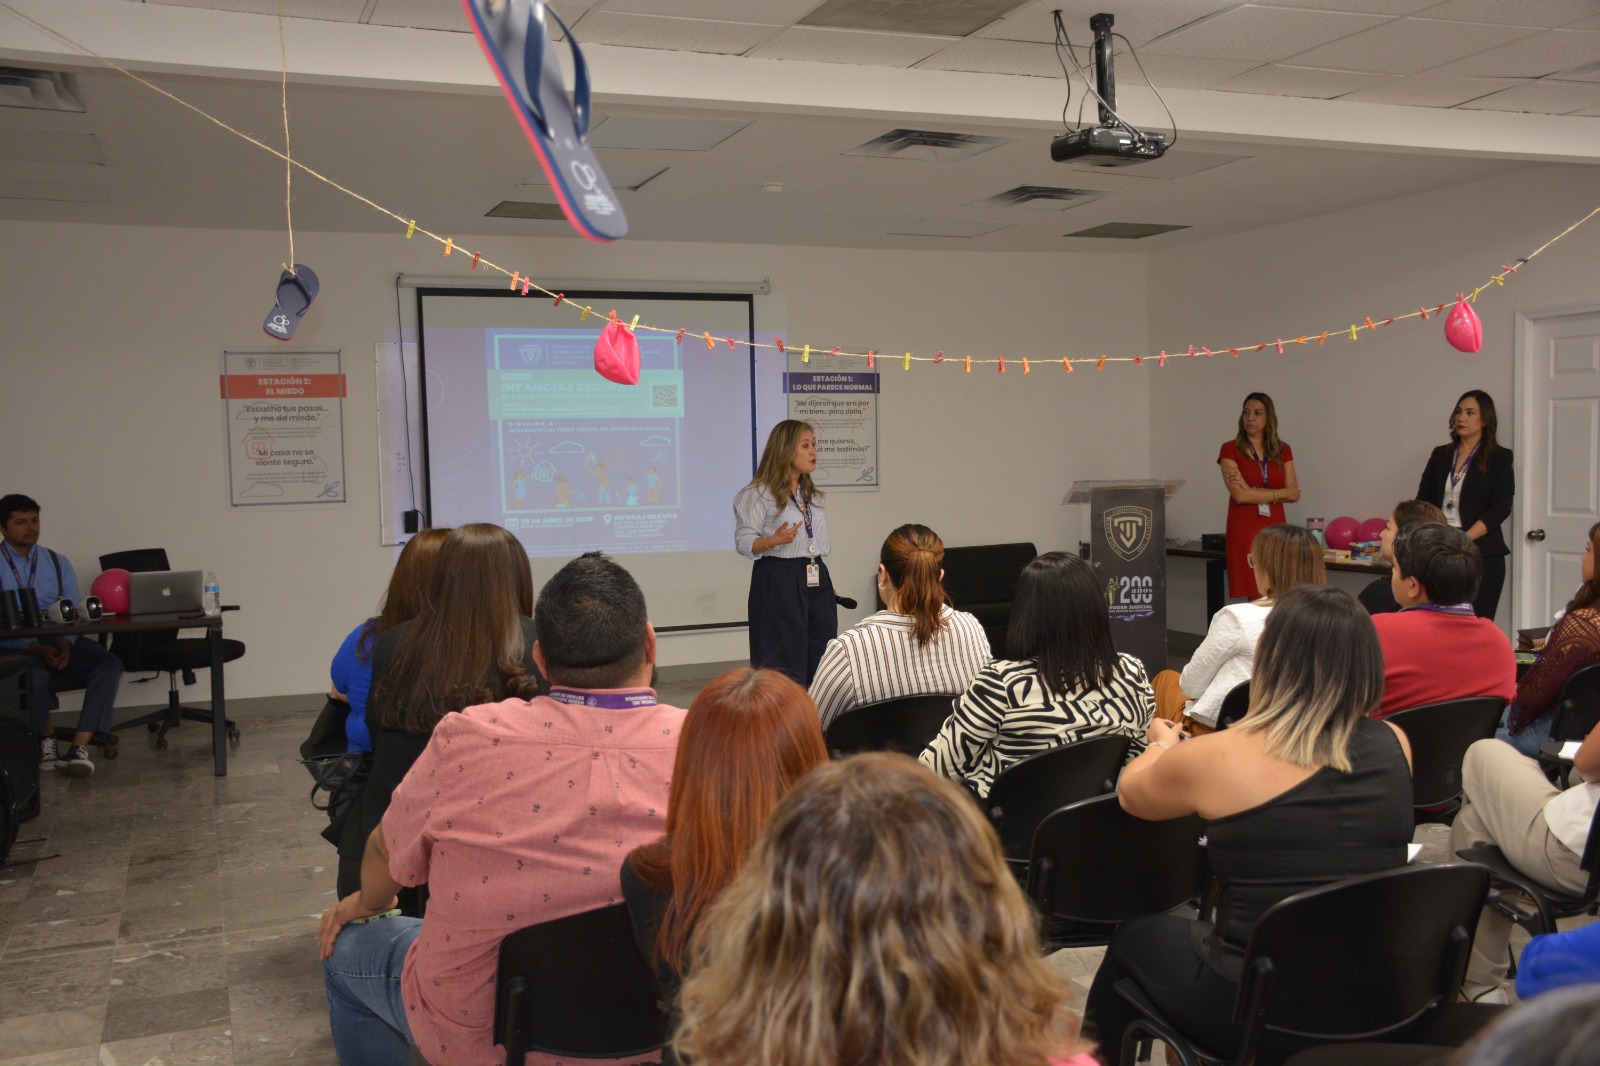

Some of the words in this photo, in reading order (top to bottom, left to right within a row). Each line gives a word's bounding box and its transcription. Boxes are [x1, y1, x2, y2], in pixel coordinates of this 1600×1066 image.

[258, 376, 302, 385] ESTACIÓN
[501, 383, 574, 392] INFANCIAS
[858, 401, 869, 409] por
